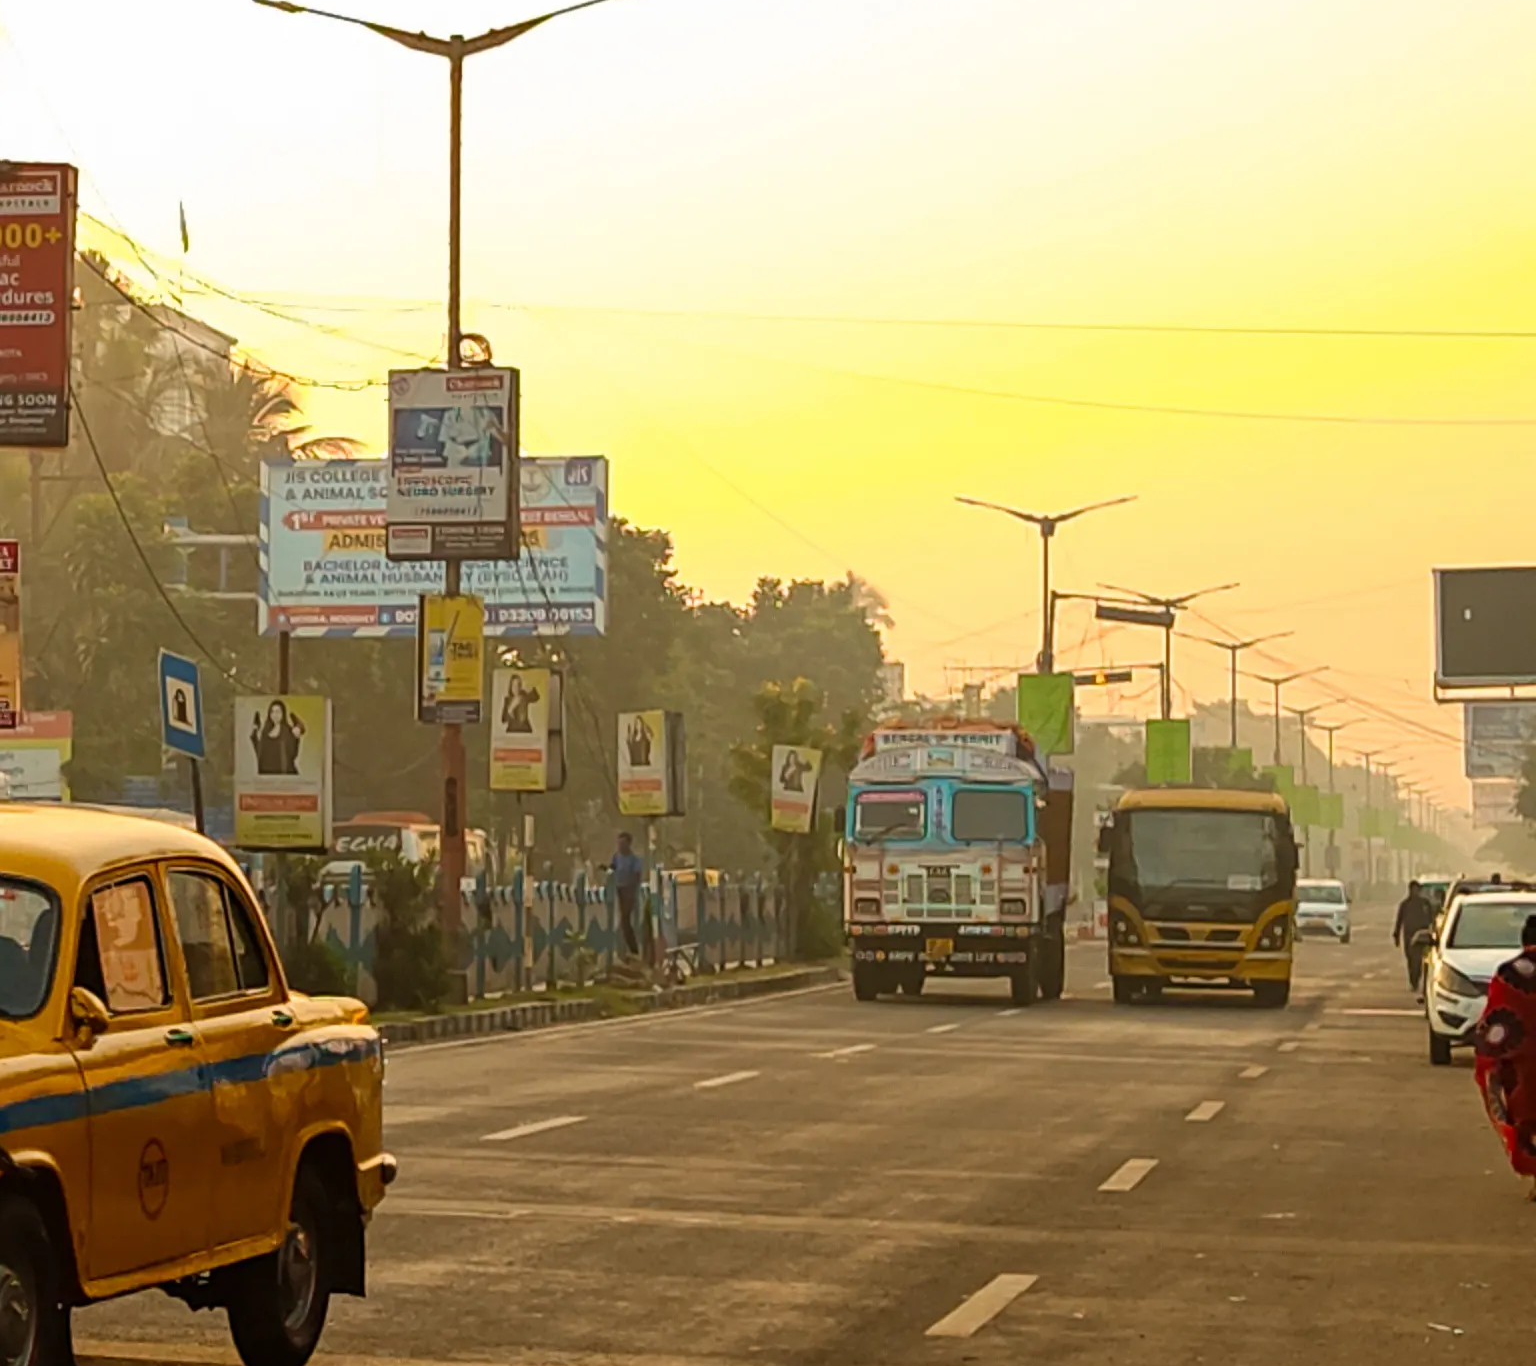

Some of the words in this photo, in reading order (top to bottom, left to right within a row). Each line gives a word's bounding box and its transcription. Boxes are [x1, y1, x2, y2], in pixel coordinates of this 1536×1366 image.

[17, 393, 58, 406] SOON
[284, 470, 306, 484] JIS
[310, 469, 380, 484] COLLEGE
[302, 487, 365, 501] ANIMAL
[367, 488, 388, 499] SC
[321, 515, 367, 526] PRIVATE
[368, 515, 387, 526] VE
[520, 512, 542, 523] EST
[329, 533, 386, 550] ADMIS
[303, 559, 382, 572] BACHELOR
[319, 573, 378, 585] ANIMAL
